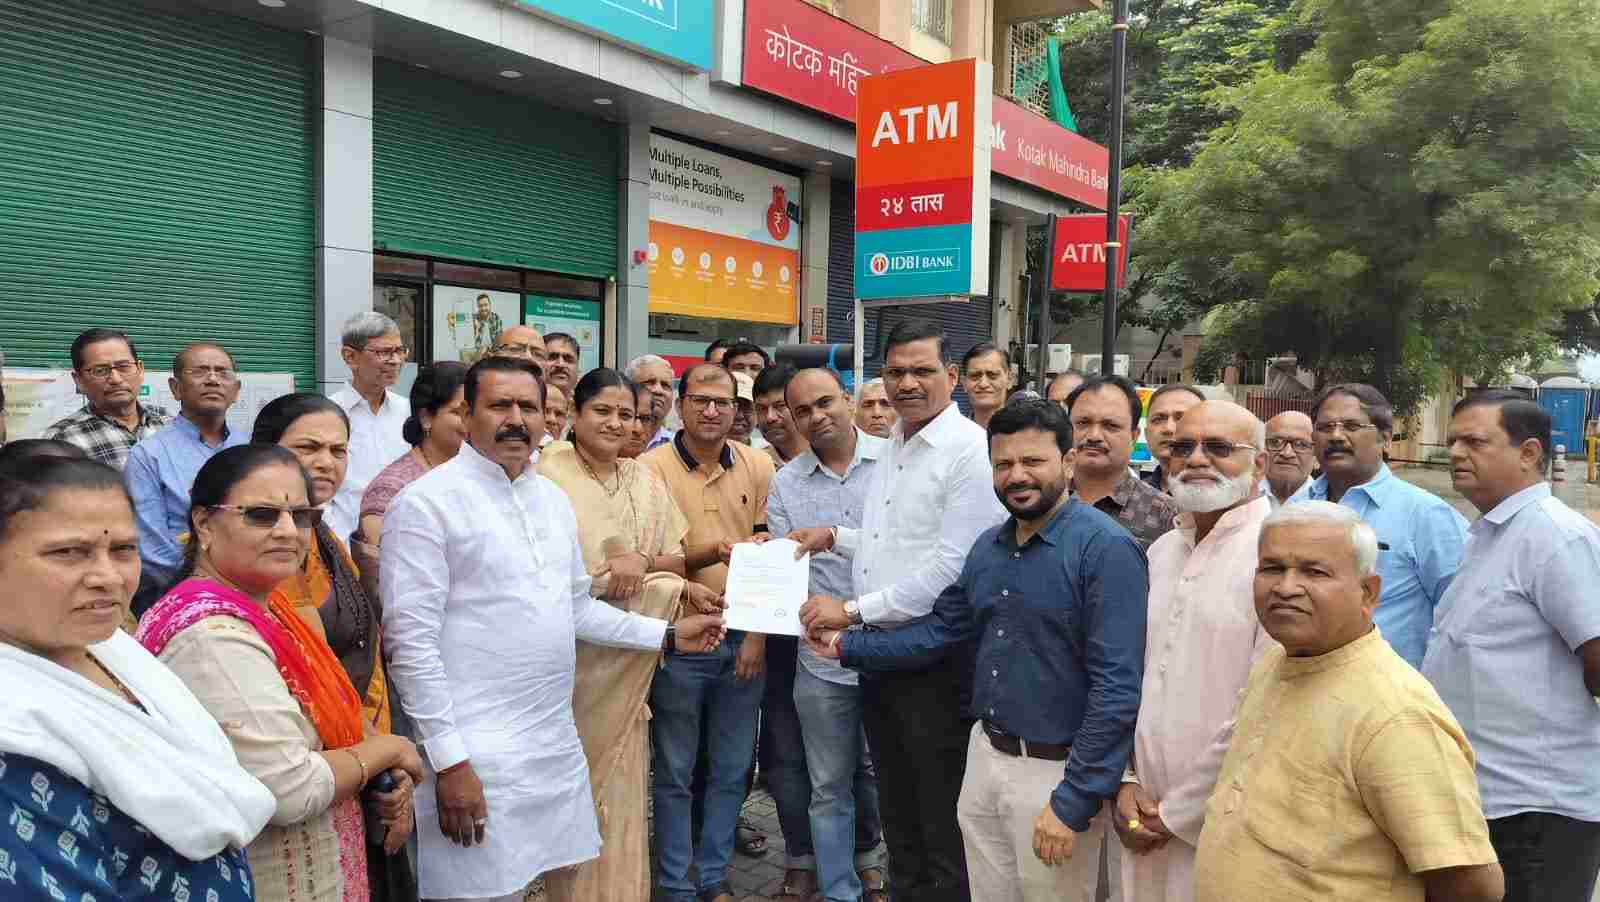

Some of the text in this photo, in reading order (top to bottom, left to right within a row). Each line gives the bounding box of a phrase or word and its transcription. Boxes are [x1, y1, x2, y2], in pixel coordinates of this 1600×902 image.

[765, 24, 823, 78] कोटक
[871, 101, 958, 148] ATM
[692, 158, 722, 179] Loans,
[1017, 136, 1047, 168] Kotak
[1048, 150, 1090, 186] Mahindra
[692, 177, 745, 203] Possibilities
[880, 193, 945, 217] २४ तास
[891, 255, 954, 271] IDBI BANK
